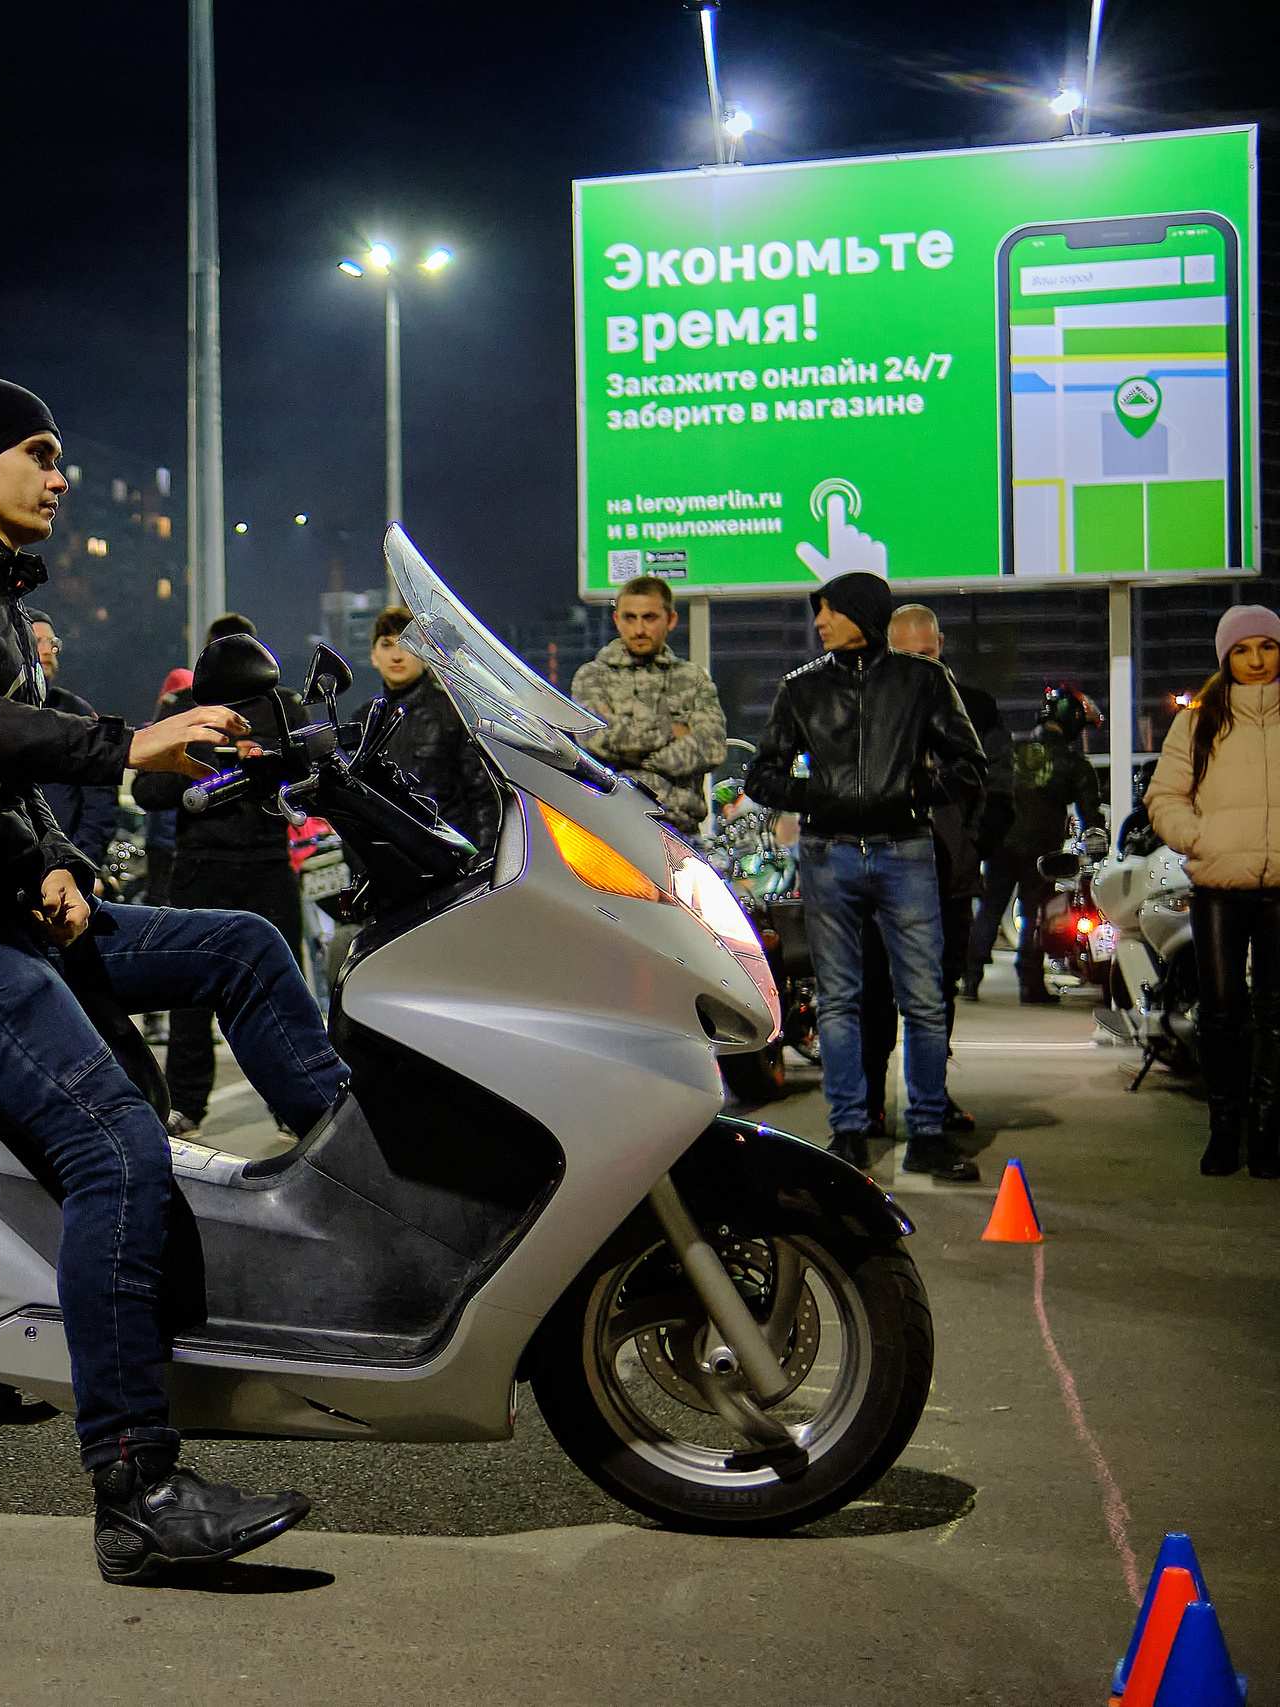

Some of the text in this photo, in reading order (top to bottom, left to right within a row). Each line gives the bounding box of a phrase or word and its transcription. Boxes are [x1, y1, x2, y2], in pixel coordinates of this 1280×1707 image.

[603, 229, 955, 291] Экономьте
[605, 293, 818, 363] время!
[606, 352, 954, 398] Закажите онлайн 24/7
[606, 393, 925, 432] заберите в магазине
[606, 489, 783, 516] на leroymerlin.ru
[606, 517, 783, 542] и в приложении
